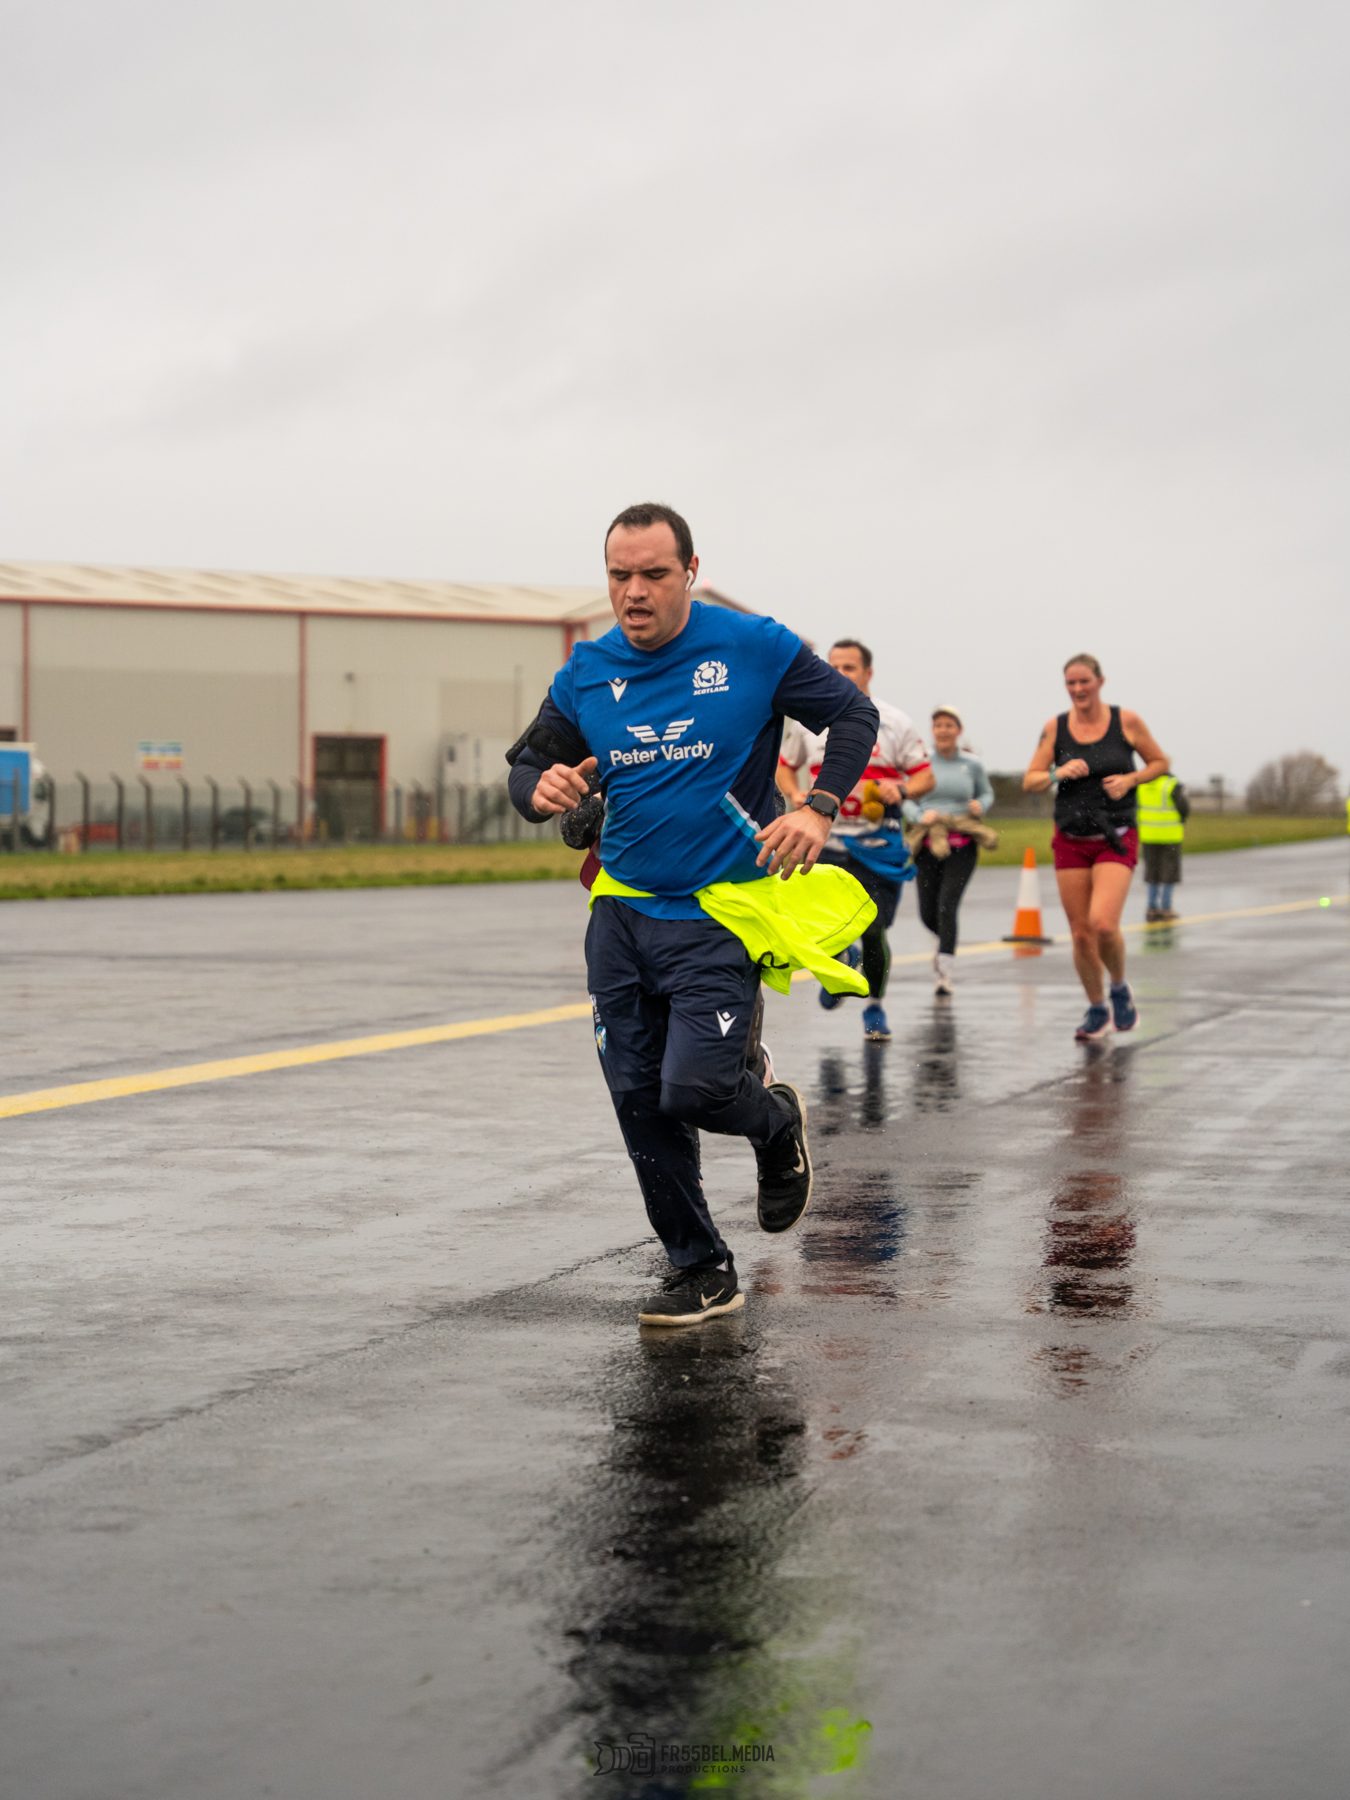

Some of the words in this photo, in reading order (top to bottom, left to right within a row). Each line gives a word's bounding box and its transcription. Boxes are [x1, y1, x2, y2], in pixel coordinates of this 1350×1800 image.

[693, 685, 730, 696] SCOTLAND
[609, 750, 658, 766] Peter
[661, 740, 714, 760] Vardy
